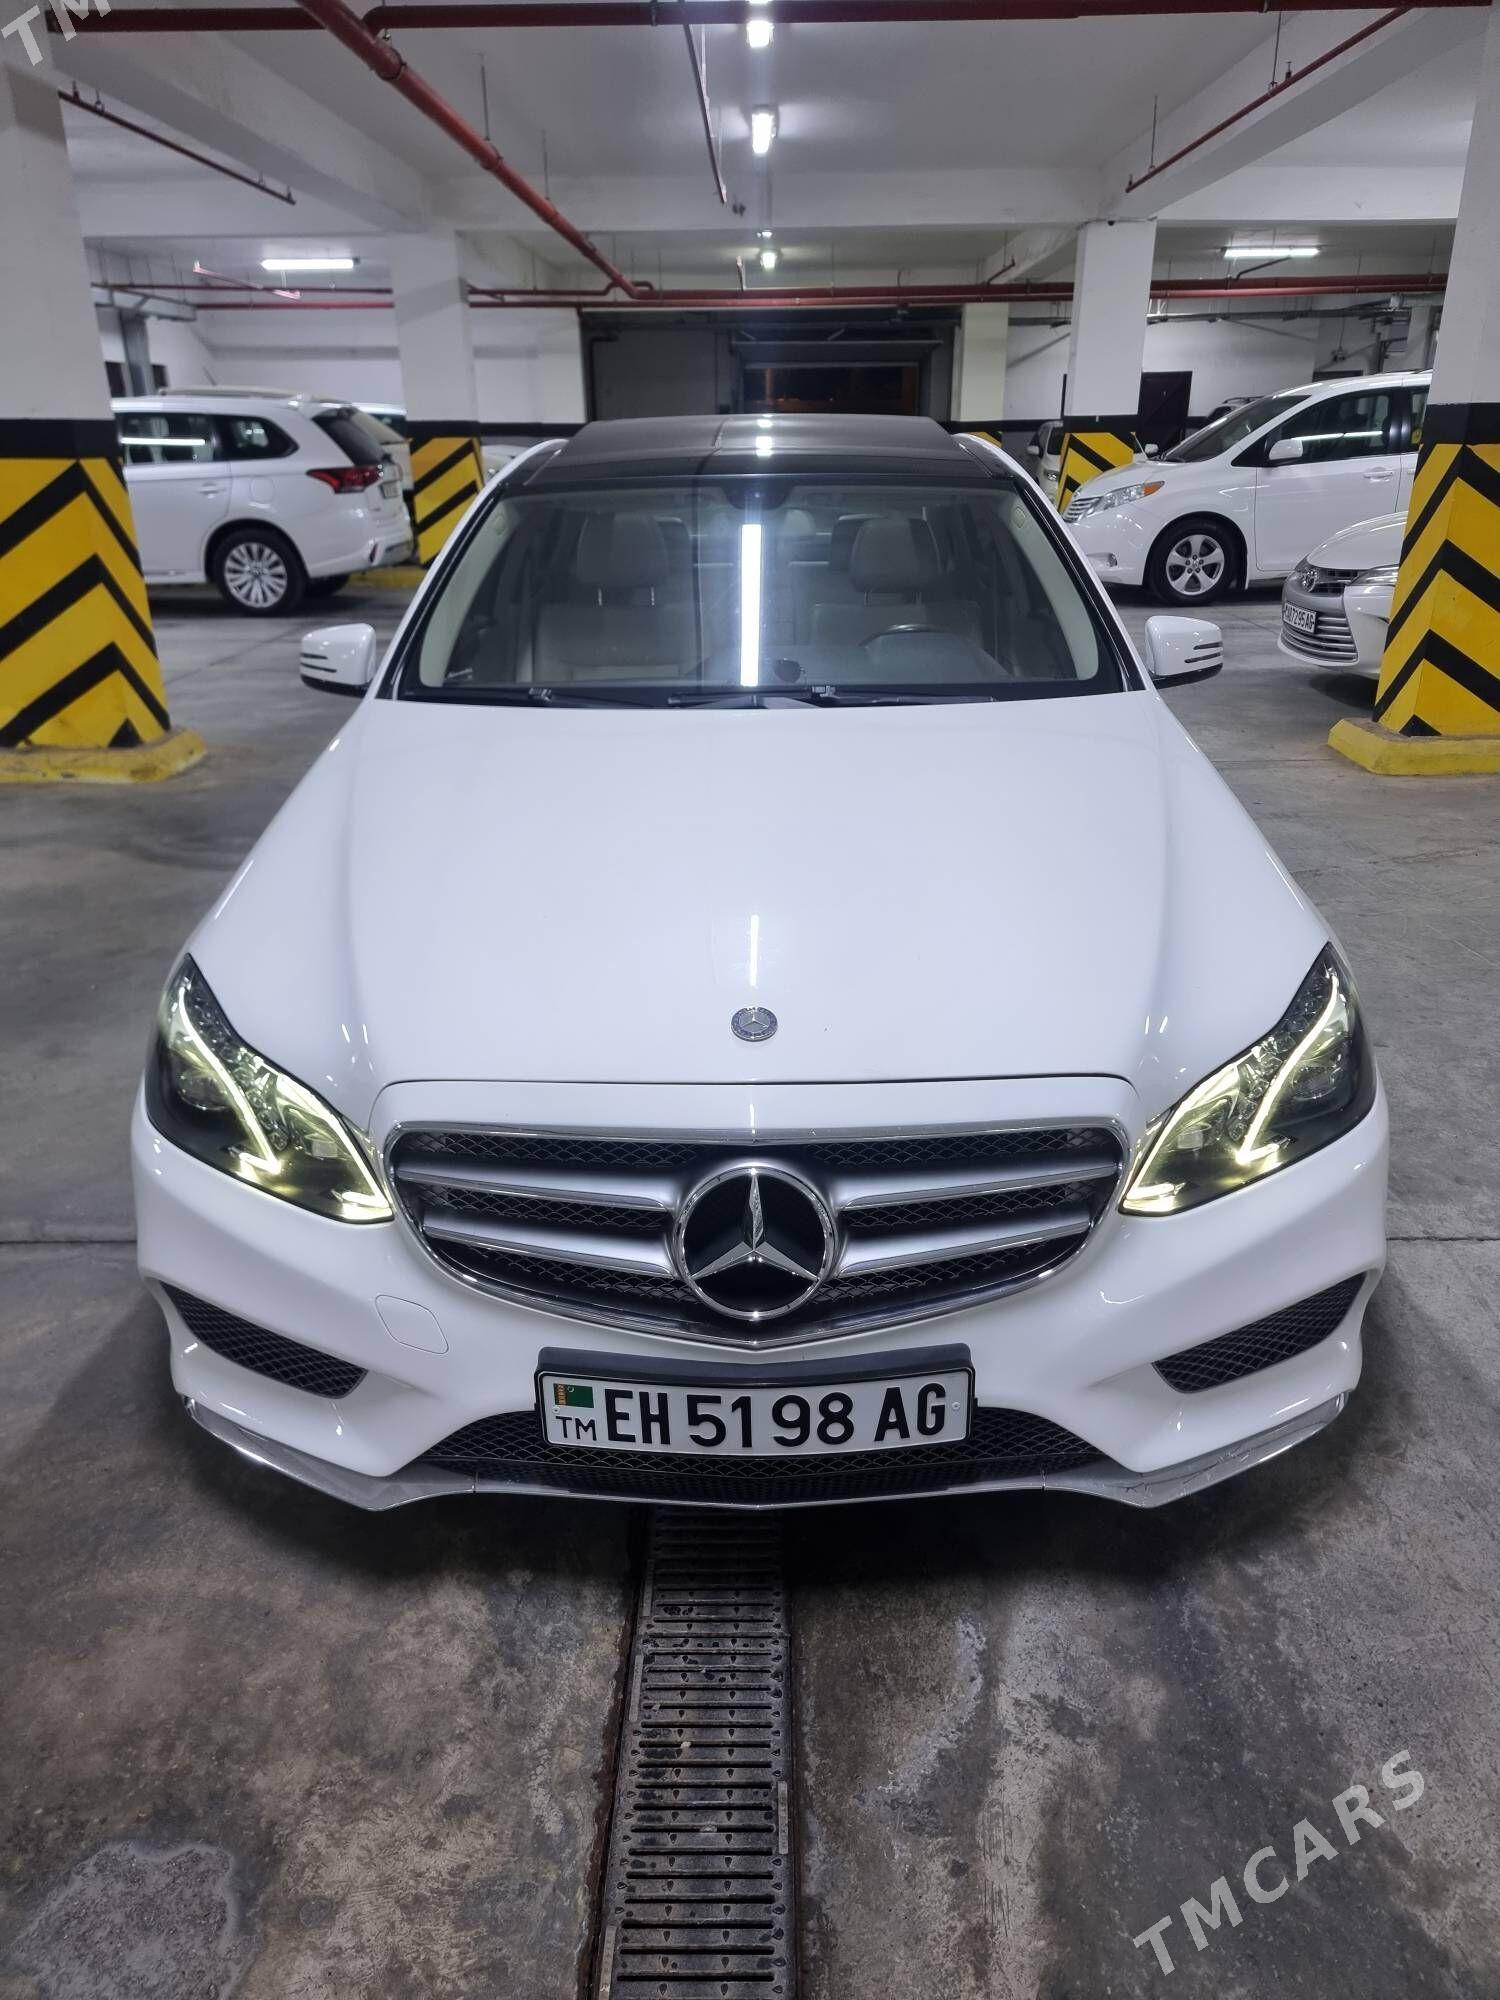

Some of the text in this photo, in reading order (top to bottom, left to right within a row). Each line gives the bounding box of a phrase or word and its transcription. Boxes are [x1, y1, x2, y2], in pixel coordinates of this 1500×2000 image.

[555, 1415, 597, 1441] TM
[604, 1389, 671, 1445] EH
[874, 1383, 946, 1442] AG
